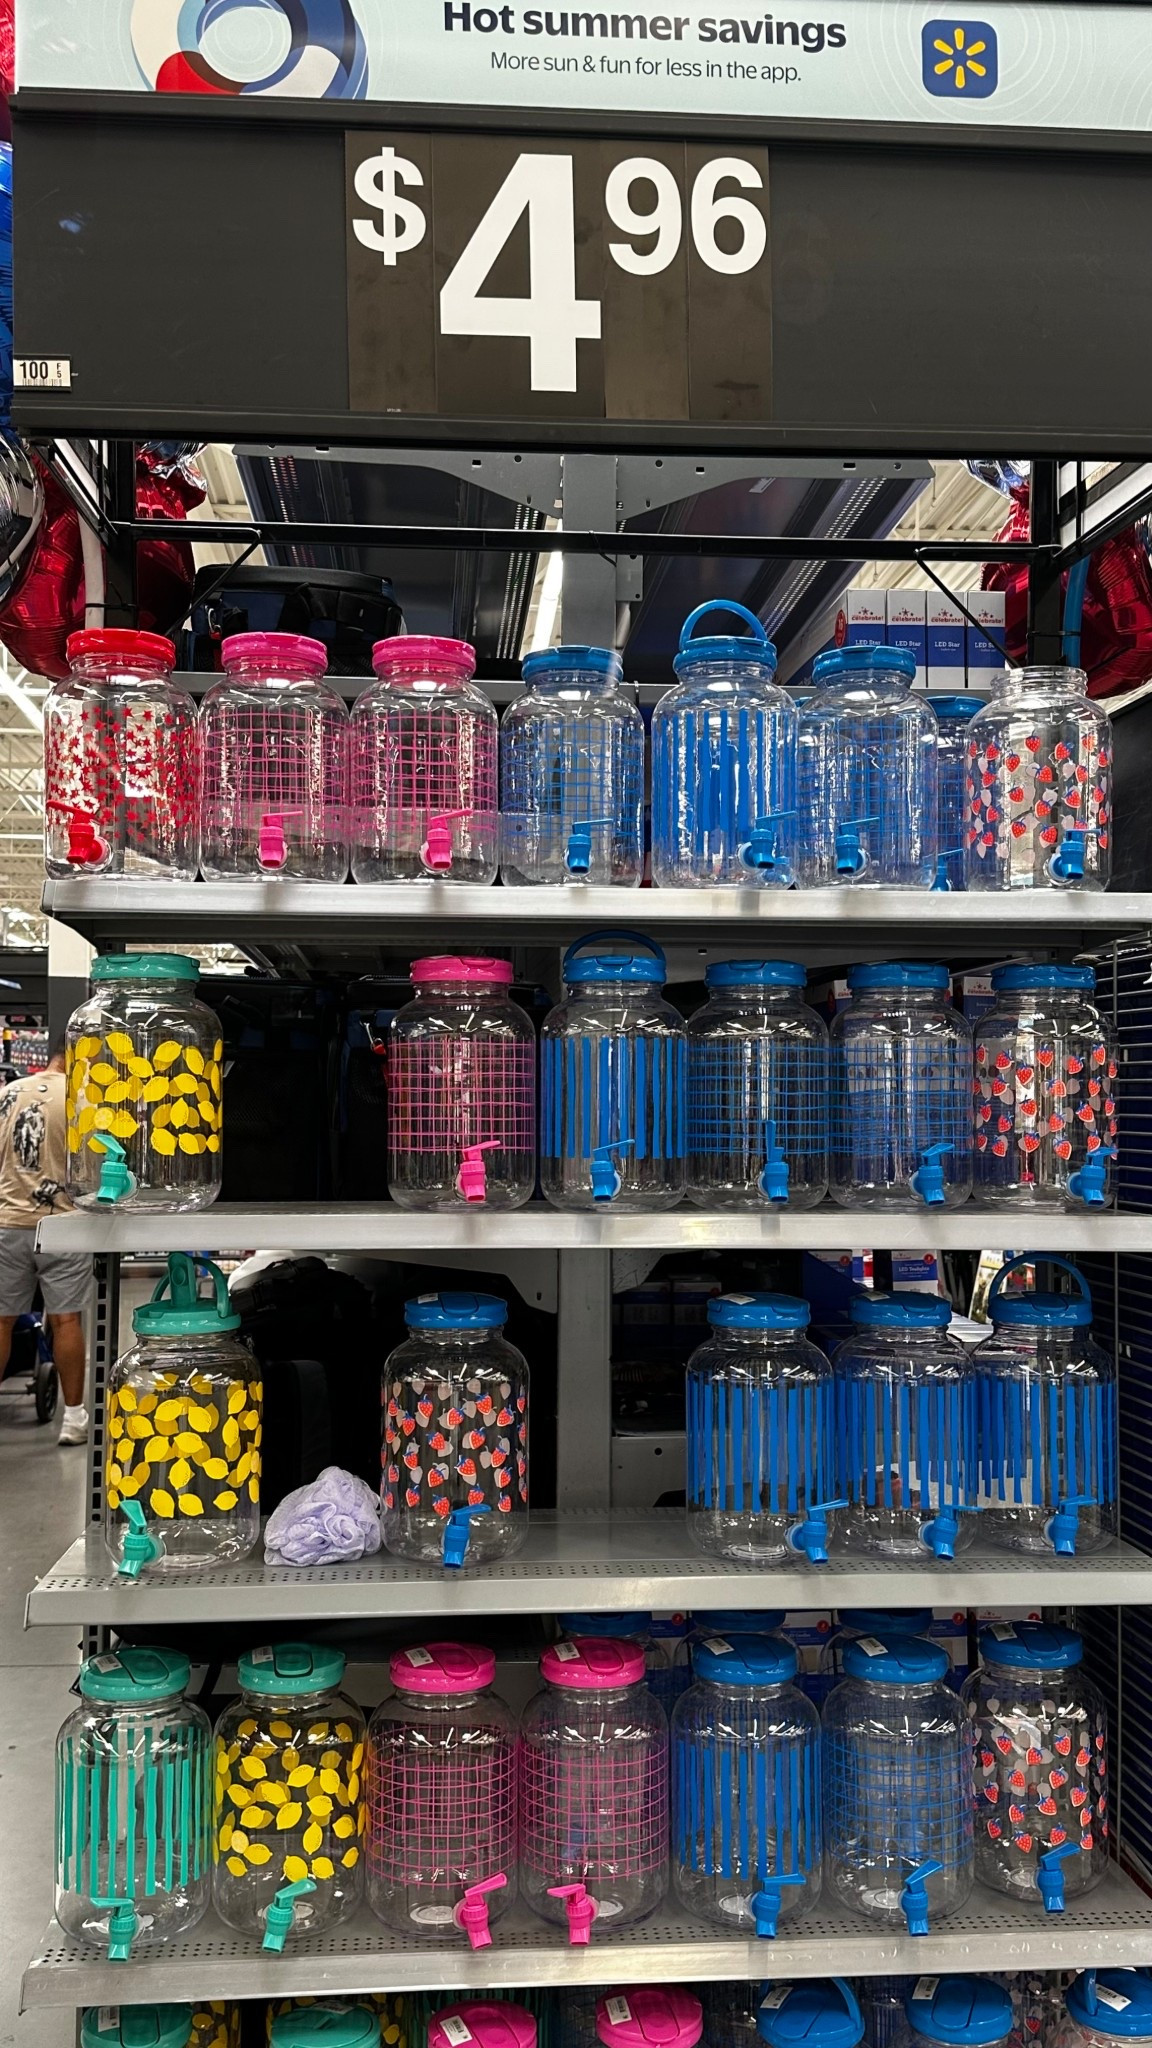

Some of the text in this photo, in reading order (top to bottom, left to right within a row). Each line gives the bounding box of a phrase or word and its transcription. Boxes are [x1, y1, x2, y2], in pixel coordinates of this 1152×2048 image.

[443, 1, 847, 54] Hot summer savings
[491, 51, 802, 85] More sun & fun for less in the app.
[20, 361, 49, 379] 100
